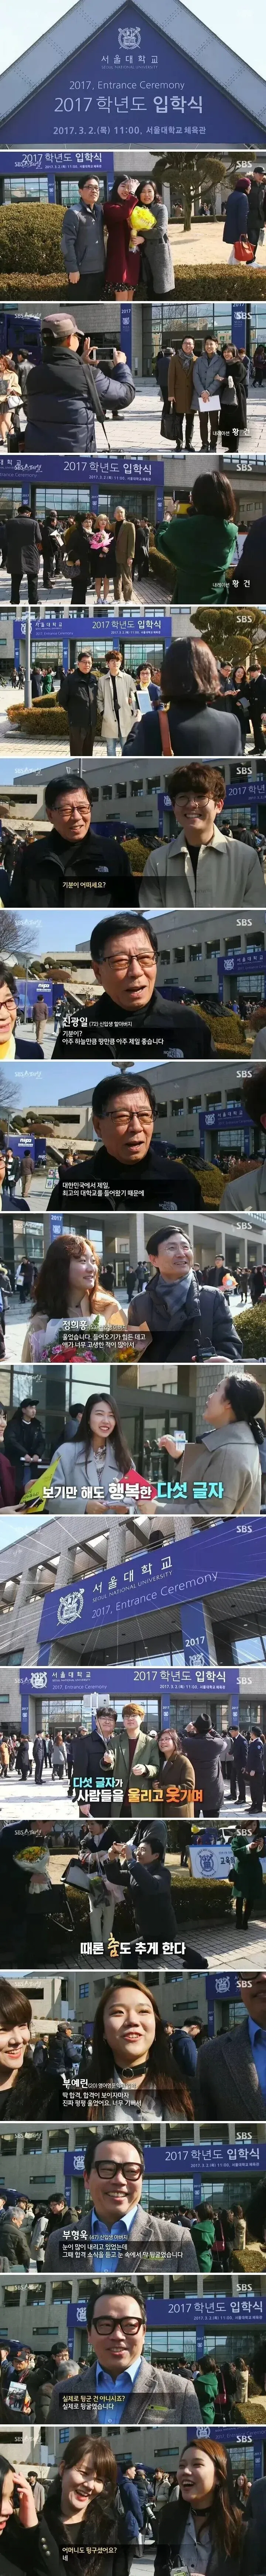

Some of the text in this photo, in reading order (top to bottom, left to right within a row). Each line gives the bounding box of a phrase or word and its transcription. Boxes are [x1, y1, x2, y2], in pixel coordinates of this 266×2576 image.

[69, 80, 185, 91] 2017, Entrance Ceremony
[153, 96, 203, 114] 입학식
[114, 126, 206, 135] 11:00, 서울대학교 체육관
[75, 153, 102, 162] 입학식
[123, 463, 151, 475] 입학식
[138, 620, 161, 629] 입학식
[92, 1570, 173, 1603] SEOUL NATIONAL UNIVERSITY
[92, 1572, 218, 1618] 2017, Entrance Ceremony
[185, 1636, 205, 1647] 2017
[195, 1670, 226, 1683] 입학식
[227, 2148, 259, 2160] 입학식
[230, 2301, 263, 2313] 입학식
